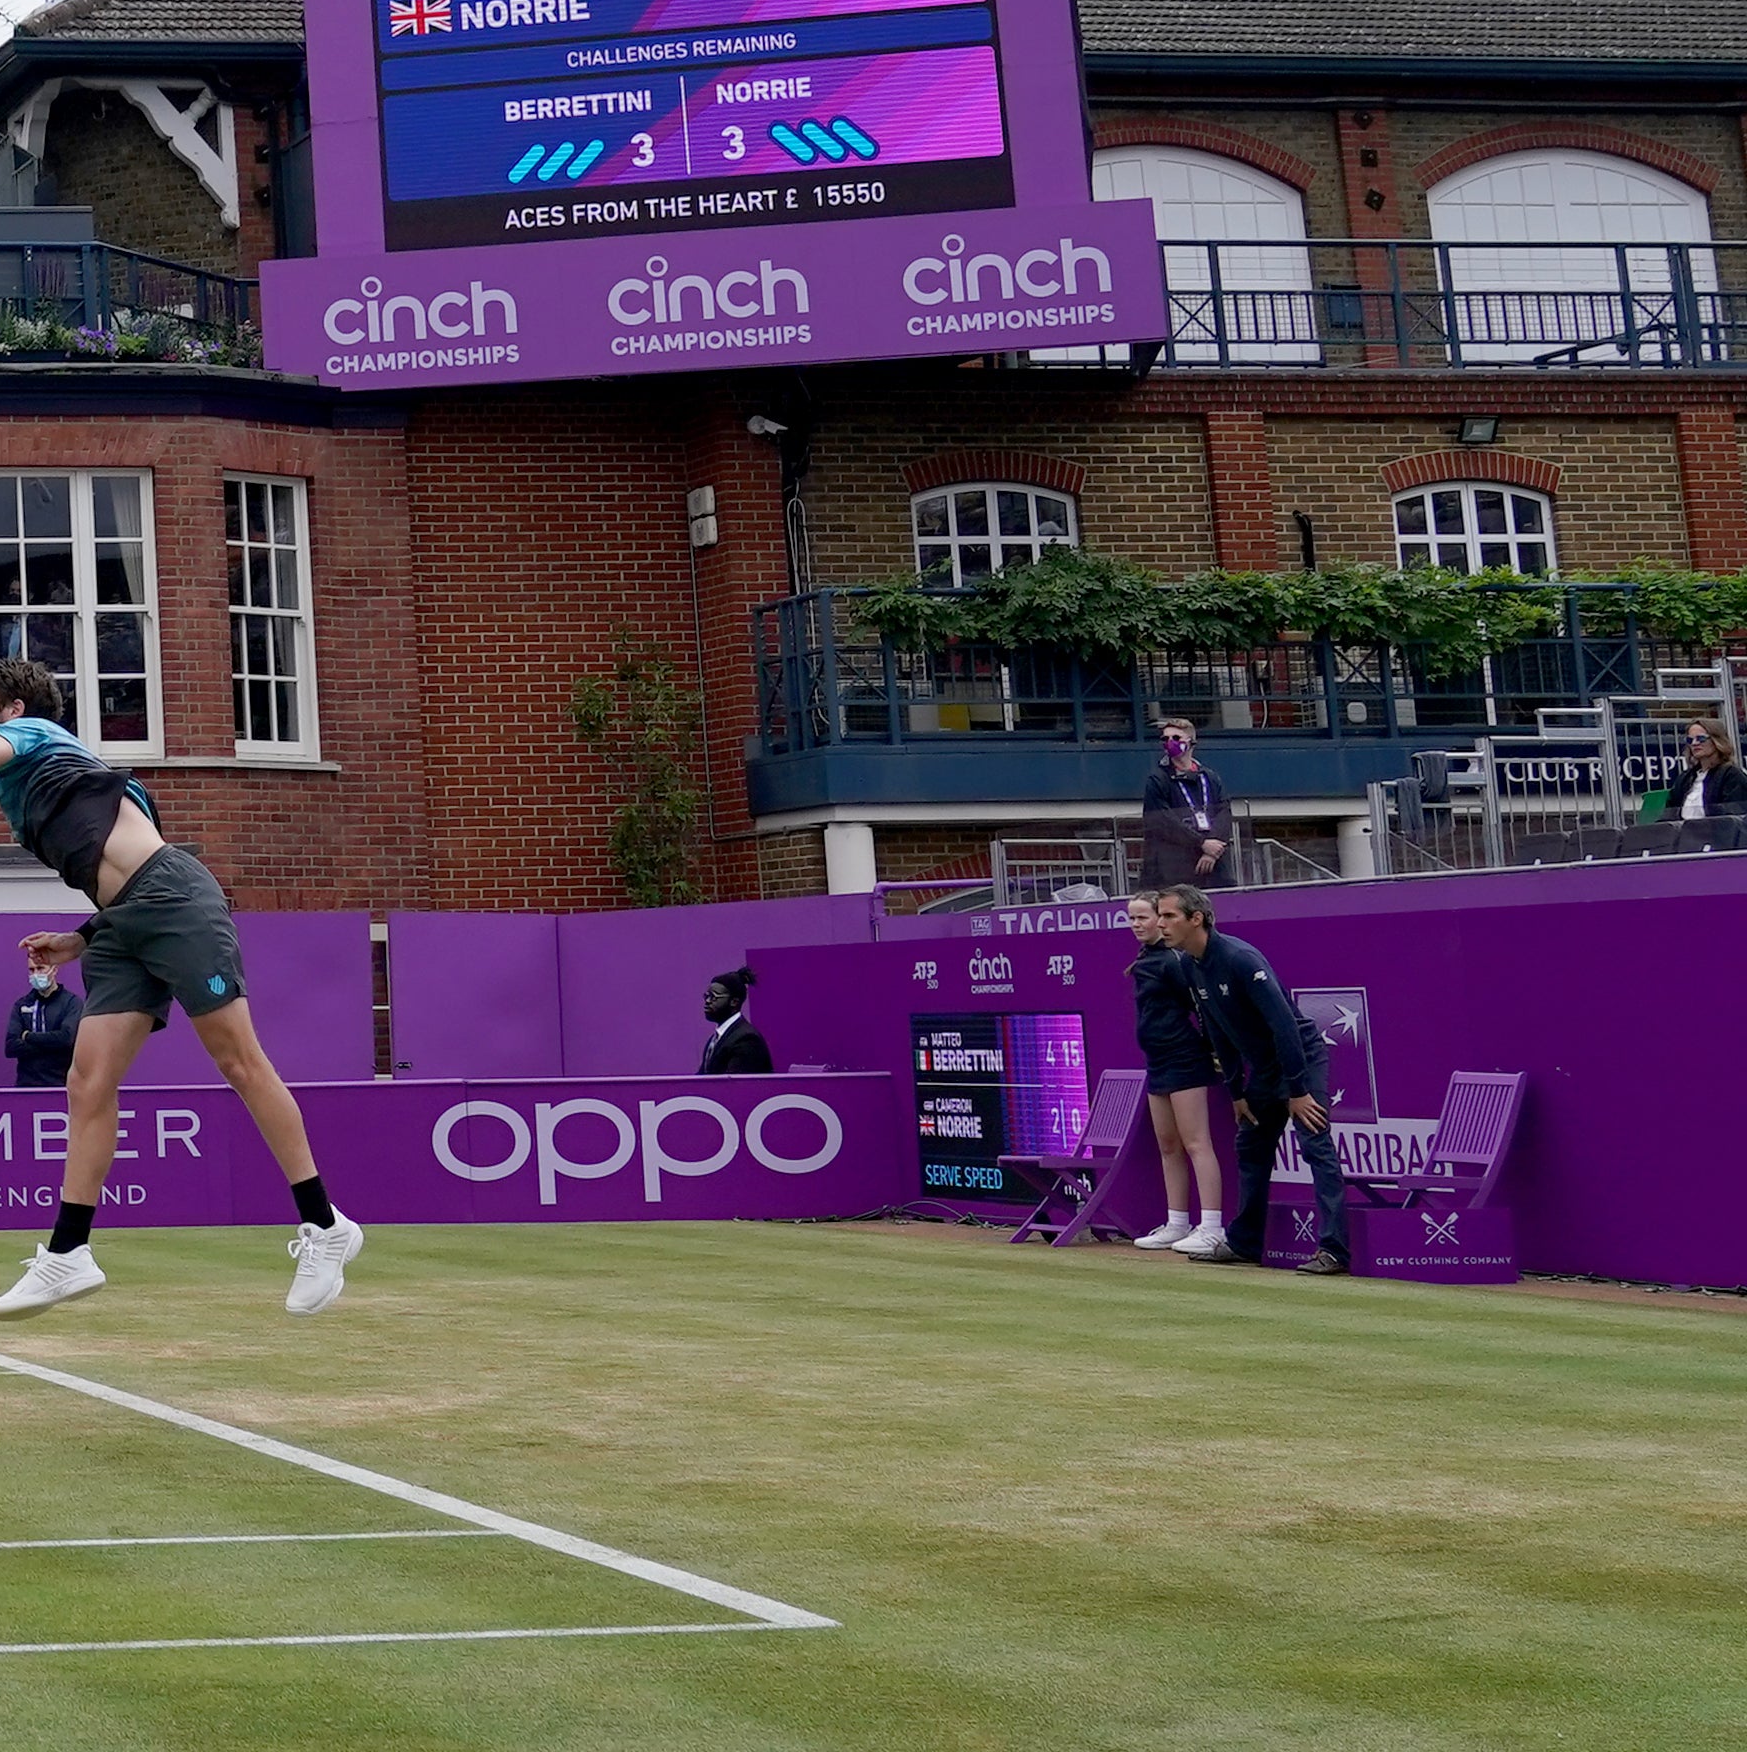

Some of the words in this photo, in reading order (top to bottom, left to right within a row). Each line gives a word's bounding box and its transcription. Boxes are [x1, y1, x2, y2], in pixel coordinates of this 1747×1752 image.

[566, 42, 688, 69] CHALLENGES
[692, 33, 797, 57] REMAINING
[504, 90, 652, 122] BERRETTINI
[715, 77, 813, 105] NORRIE
[630, 132, 656, 168] 3
[720, 125, 746, 161] 3
[504, 208, 566, 230] ACES
[572, 200, 639, 225] FROM
[644, 196, 692, 219] THE
[698, 189, 778, 216] HEART
[785, 188, 798, 209] £
[812, 181, 886, 208] 15550
[902, 234, 1112, 305] cinch
[608, 255, 810, 325] cinch
[323, 276, 518, 345] cinch
[907, 303, 1115, 336] CHAMPIONSHIPS
[610, 323, 812, 356] CHAMPIONSHIPS
[325, 344, 520, 375] CHAMPIONSHIPS
[912, 961, 937, 980] ATP
[968, 948, 1013, 981] cinch
[1046, 955, 1074, 976] ATP
[931, 1032, 962, 1047] MATTEO
[1046, 1040, 1056, 1067] 4
[1062, 1040, 1081, 1067] 15
[933, 1049, 1004, 1072] BERRETTINI
[937, 1115, 983, 1138] NORRIE
[432, 1094, 843, 1205] oppo
[925, 1164, 962, 1187] SERVE
[964, 1166, 1003, 1189] SPEED
[1376, 1257, 1404, 1266] CREW
[1408, 1257, 1460, 1265] CLOTHING
[1463, 1256, 1512, 1265] COMPANY
